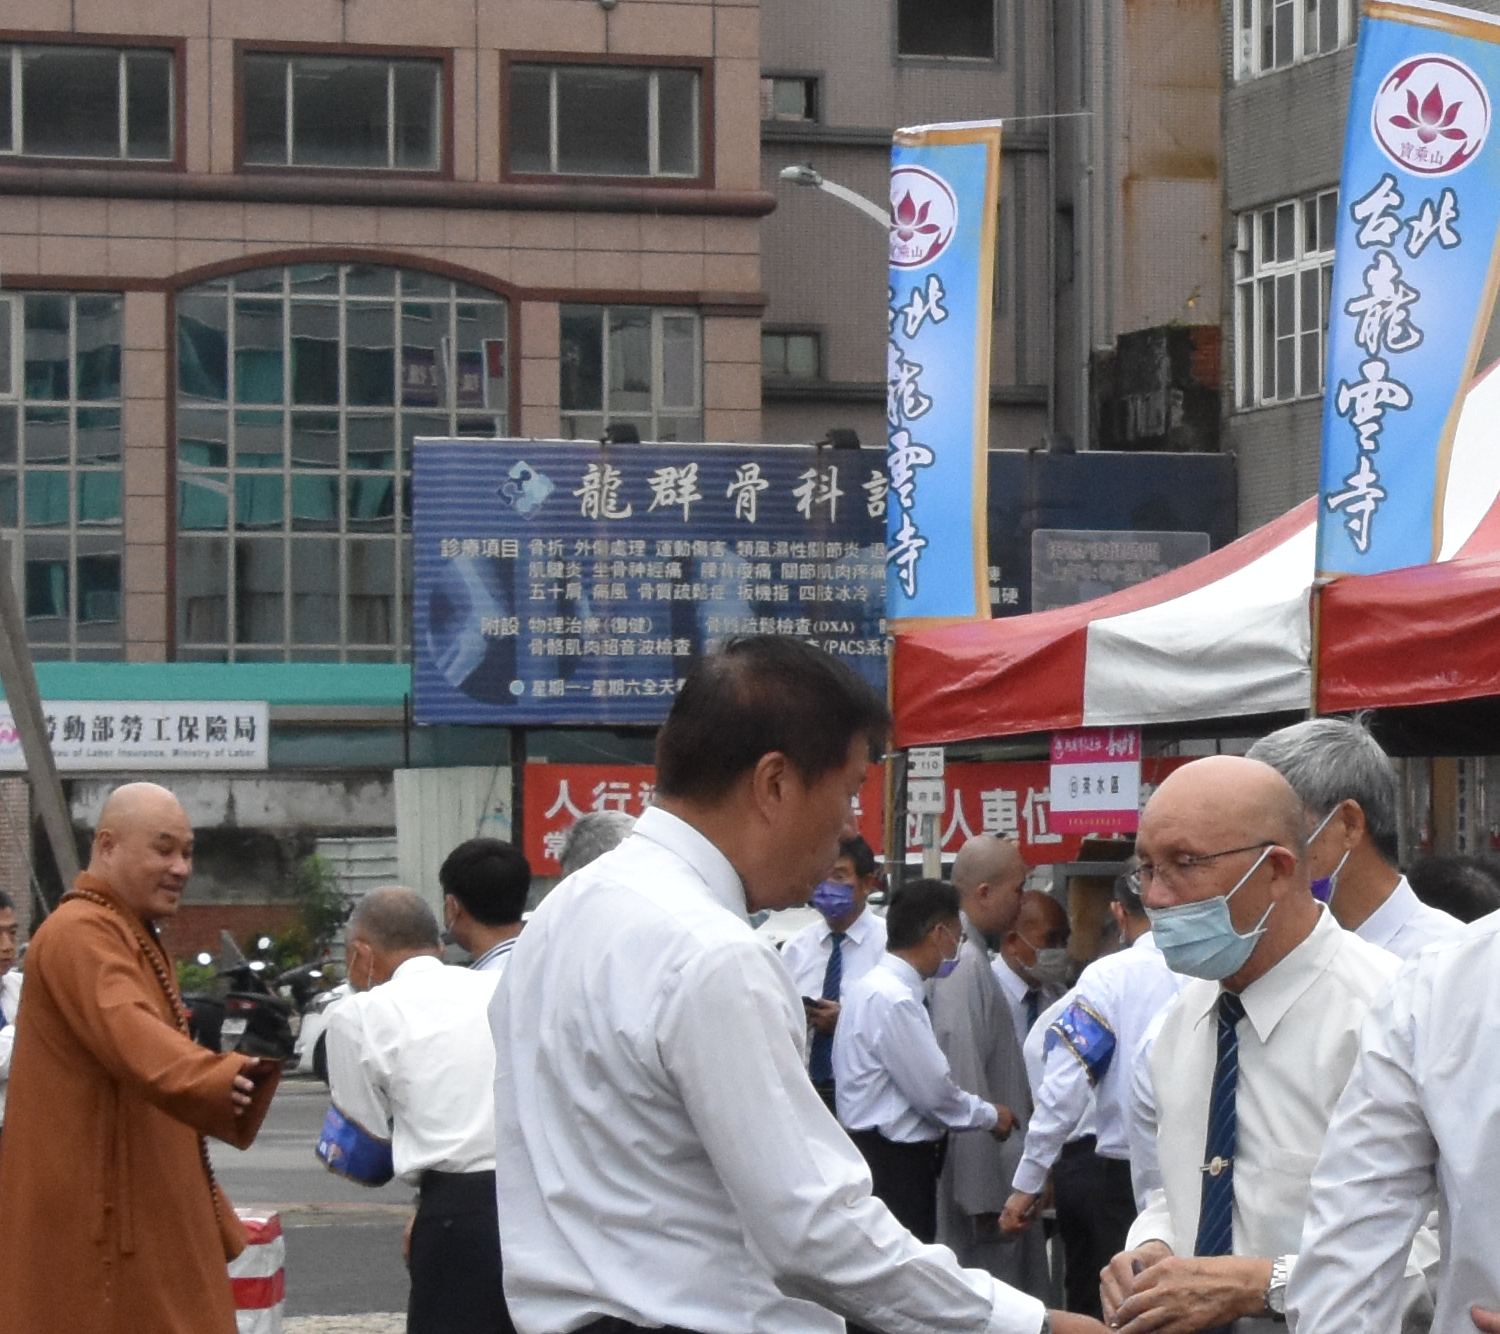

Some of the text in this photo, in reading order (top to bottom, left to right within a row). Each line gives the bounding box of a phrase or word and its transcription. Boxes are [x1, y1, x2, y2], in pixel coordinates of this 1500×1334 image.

[441, 538, 520, 558] 診療項目
[528, 539, 564, 556] 骨折
[528, 583, 582, 600] 五十肩
[592, 583, 627, 600] 痛風
[481, 617, 520, 636] 附設
